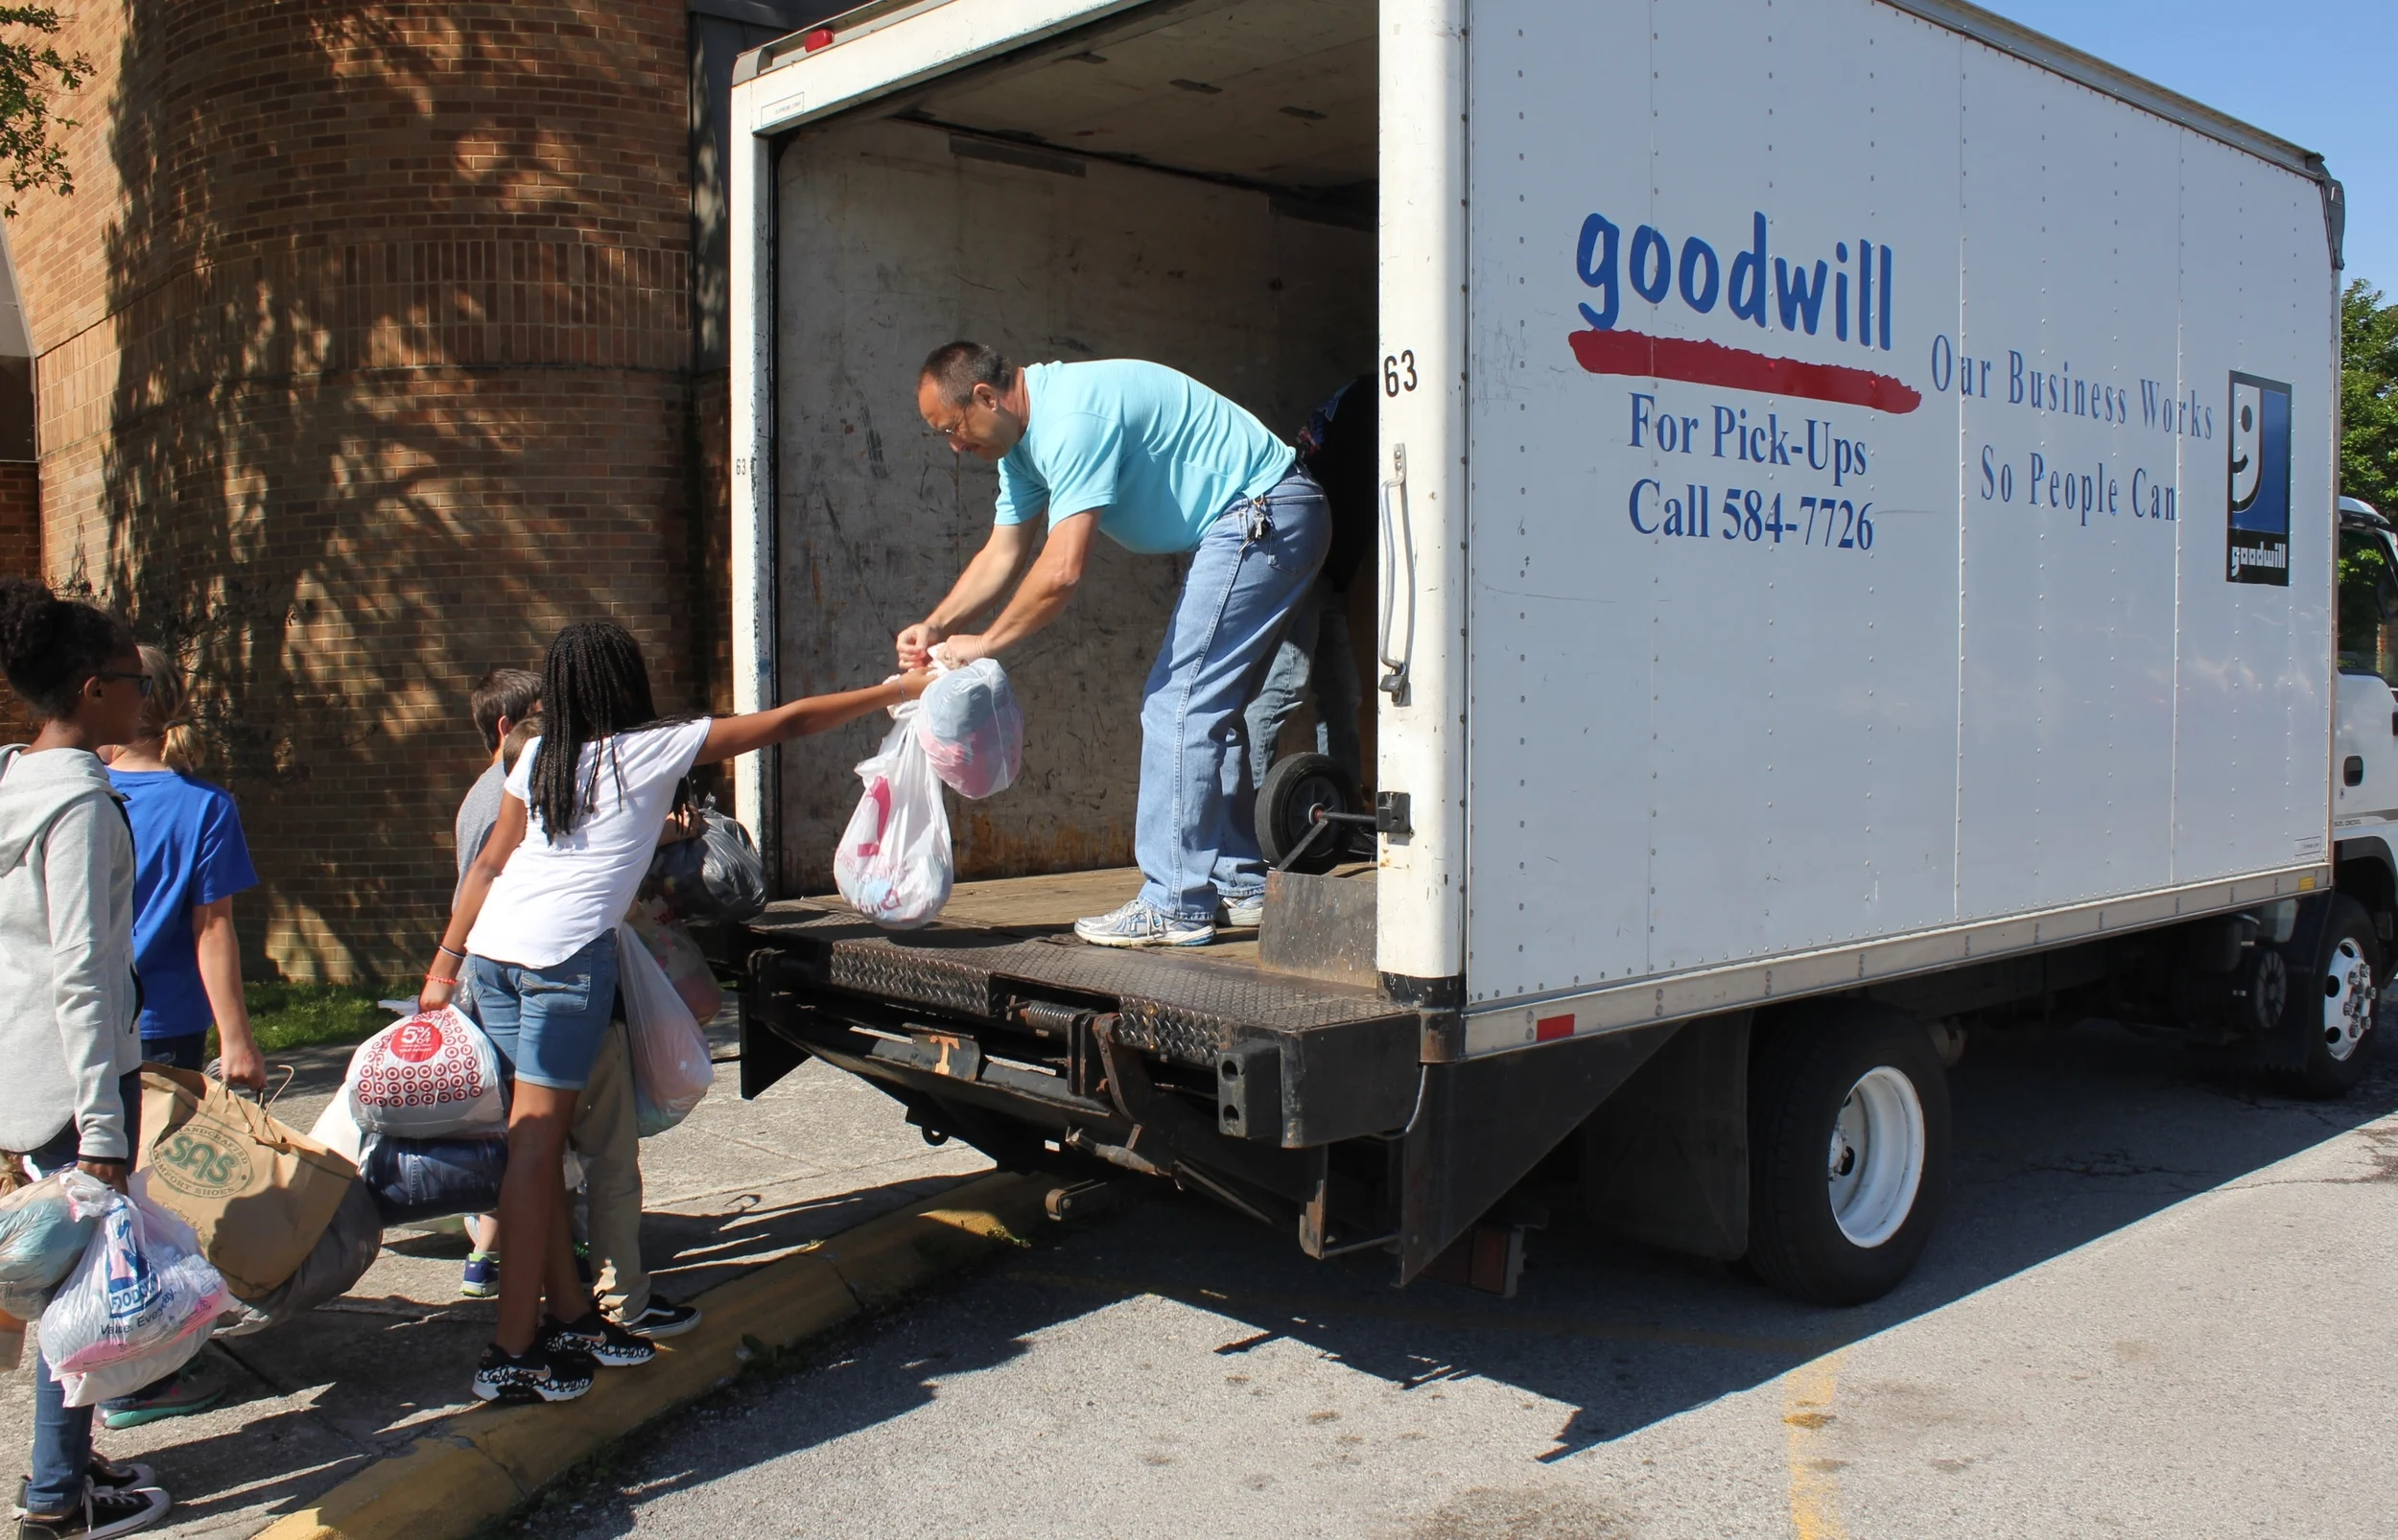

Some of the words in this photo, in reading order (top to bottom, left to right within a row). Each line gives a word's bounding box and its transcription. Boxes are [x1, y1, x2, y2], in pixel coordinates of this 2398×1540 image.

[1576, 211, 1892, 351] goodwill
[1383, 349, 1418, 398] 63
[1931, 334, 1990, 399] Our
[2008, 350, 2127, 425] Business
[2140, 378, 2212, 440] Works
[1628, 392, 1699, 454] For
[1711, 404, 1867, 487] Pick-Ups
[736, 457, 746, 476] 63
[1981, 444, 2012, 502] So
[2029, 452, 2118, 526] People
[2131, 467, 2175, 522] Can
[1629, 478, 1709, 538] Call
[1723, 487, 1873, 550] 584-7726
[2231, 541, 2286, 577] goodwill
[162, 1135, 238, 1186] SAS
[179, 1126, 249, 1165] ANDCRAFTED
[194, 1186, 235, 1197] SHOES
